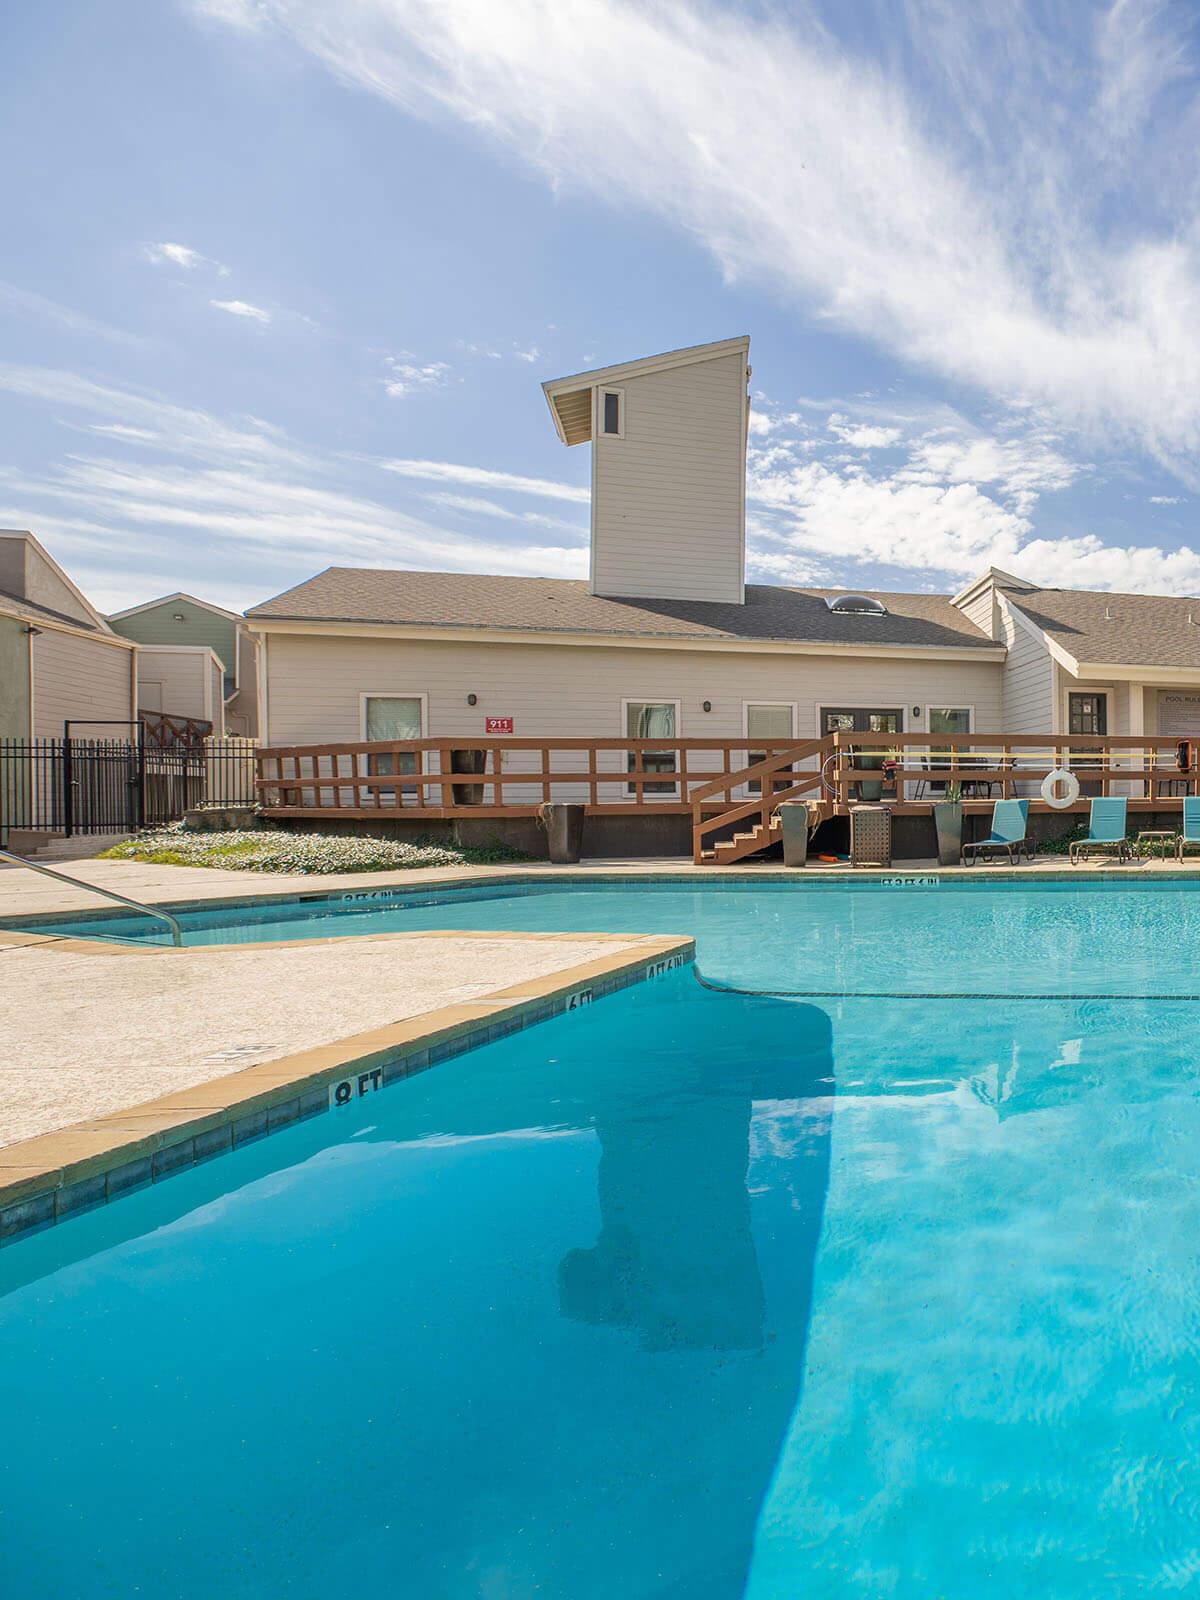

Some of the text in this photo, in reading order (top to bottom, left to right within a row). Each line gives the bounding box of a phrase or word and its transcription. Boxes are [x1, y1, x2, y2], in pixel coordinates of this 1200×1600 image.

[490, 720, 508, 728] 911
[568, 989, 592, 1011] 6 FT
[358, 1067, 382, 1098] FT
